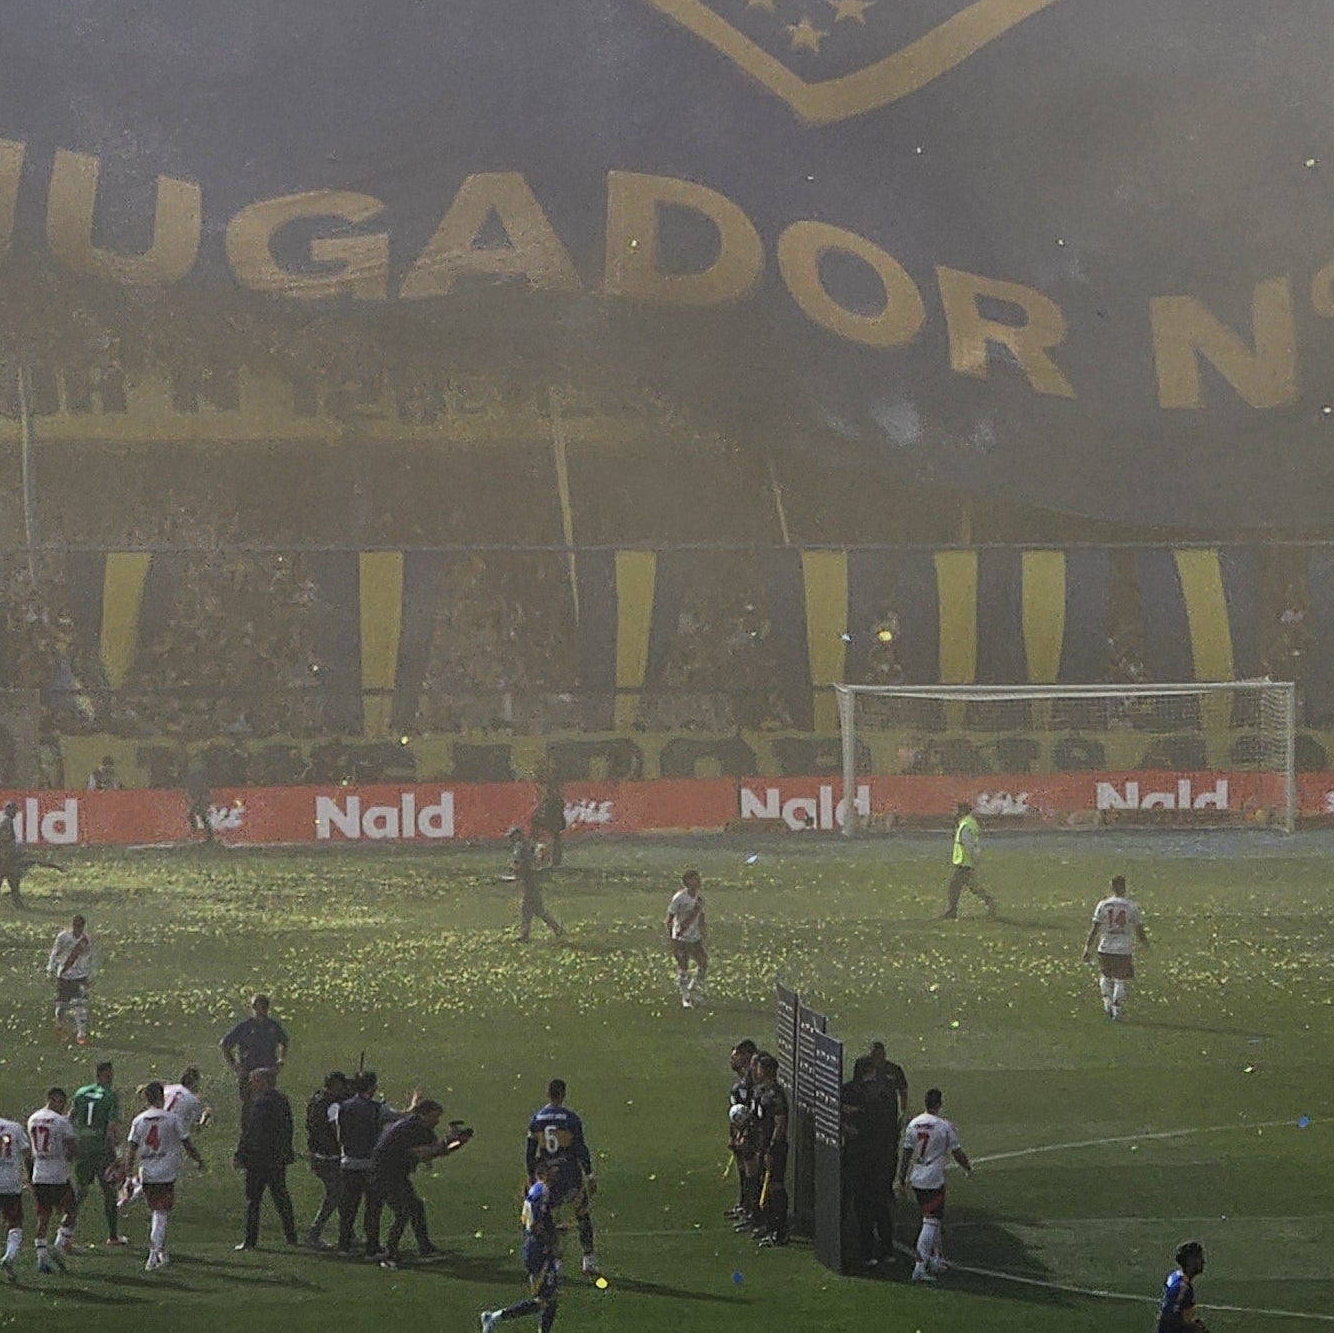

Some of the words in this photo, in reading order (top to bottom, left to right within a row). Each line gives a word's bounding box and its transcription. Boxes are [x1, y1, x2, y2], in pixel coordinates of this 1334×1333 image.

[1096, 779, 1229, 810] Nald
[316, 791, 455, 839] Nald
[544, 1125, 559, 1154] 6
[917, 1131, 931, 1158] 7
